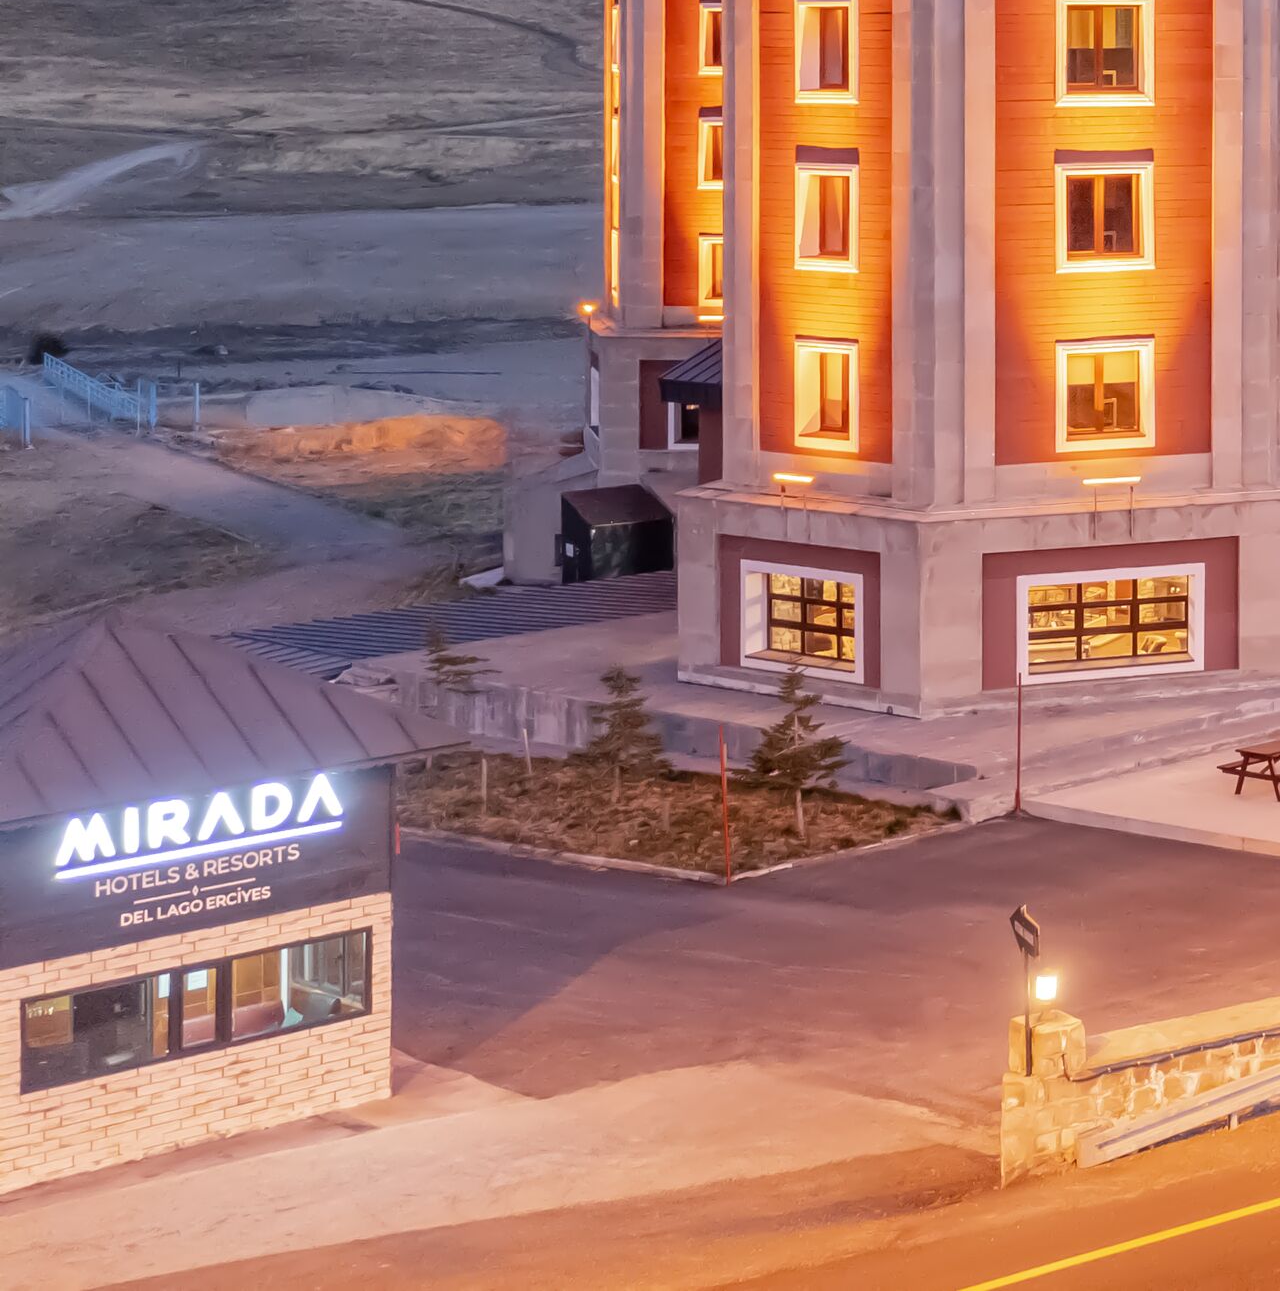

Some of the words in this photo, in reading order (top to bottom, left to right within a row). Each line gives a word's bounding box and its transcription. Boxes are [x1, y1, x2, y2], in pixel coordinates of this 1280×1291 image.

[55, 772, 344, 866] MIRADA
[94, 866, 180, 898] HOTELS
[185, 863, 200, 880] &
[203, 843, 301, 878] RESORTS
[120, 908, 154, 927] DEL
[157, 898, 203, 921] LAGO
[205, 885, 272, 909] ERCİYES
